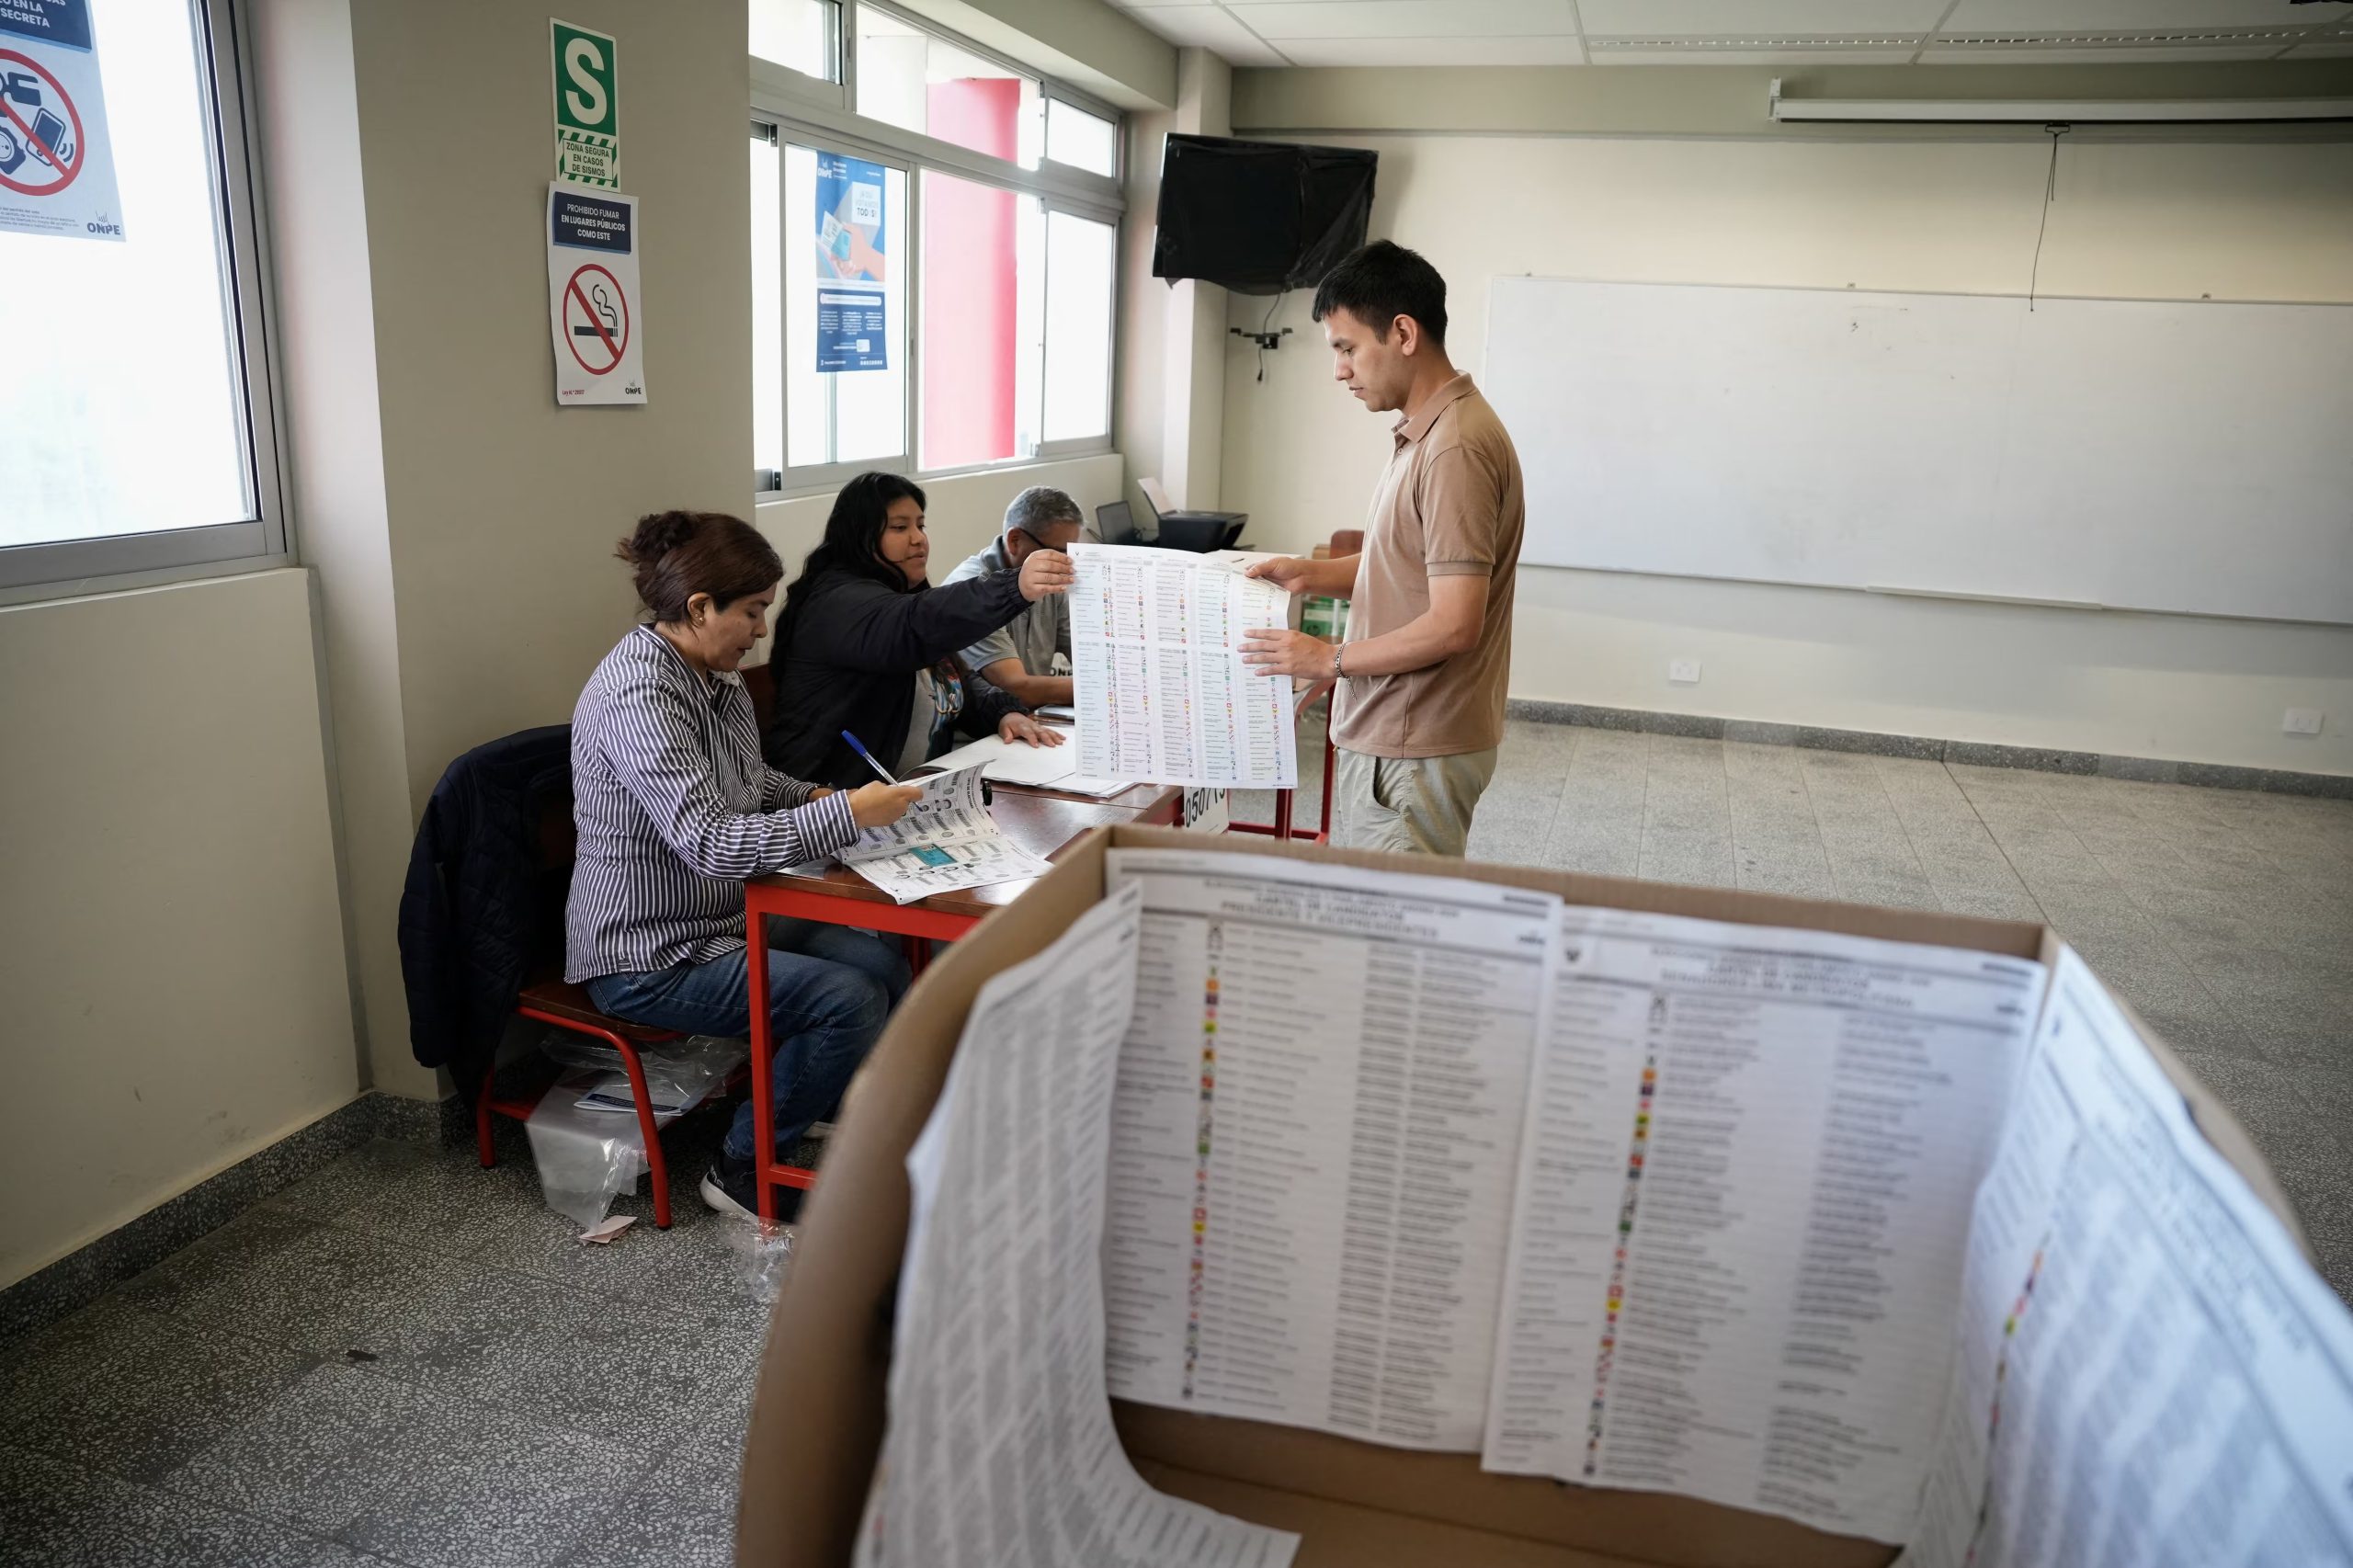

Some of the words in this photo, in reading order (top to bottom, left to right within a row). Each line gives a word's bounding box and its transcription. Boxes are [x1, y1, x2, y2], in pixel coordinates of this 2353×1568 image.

[14, 0, 28, 9] EN
[29, 2, 44, 14] LA
[0, 7, 51, 28] SECRETA
[564, 38, 608, 125] S
[566, 142, 584, 153] ZONA
[585, 145, 609, 158] SEGURA
[574, 153, 582, 163] EN
[583, 155, 604, 167] CASOS
[572, 164, 581, 172] DE
[582, 165, 605, 177] SISMOS
[566, 203, 599, 216] PROHIBIDO
[599, 209, 620, 220] FUMAR
[86, 222, 121, 235] ONPE
[561, 214, 570, 223] EN
[570, 216, 597, 227] LUGARES
[597, 218, 626, 232] PÚBLICOS
[577, 228, 597, 239] COMO
[597, 231, 611, 241] ESTE
[625, 387, 642, 395] ONPE
